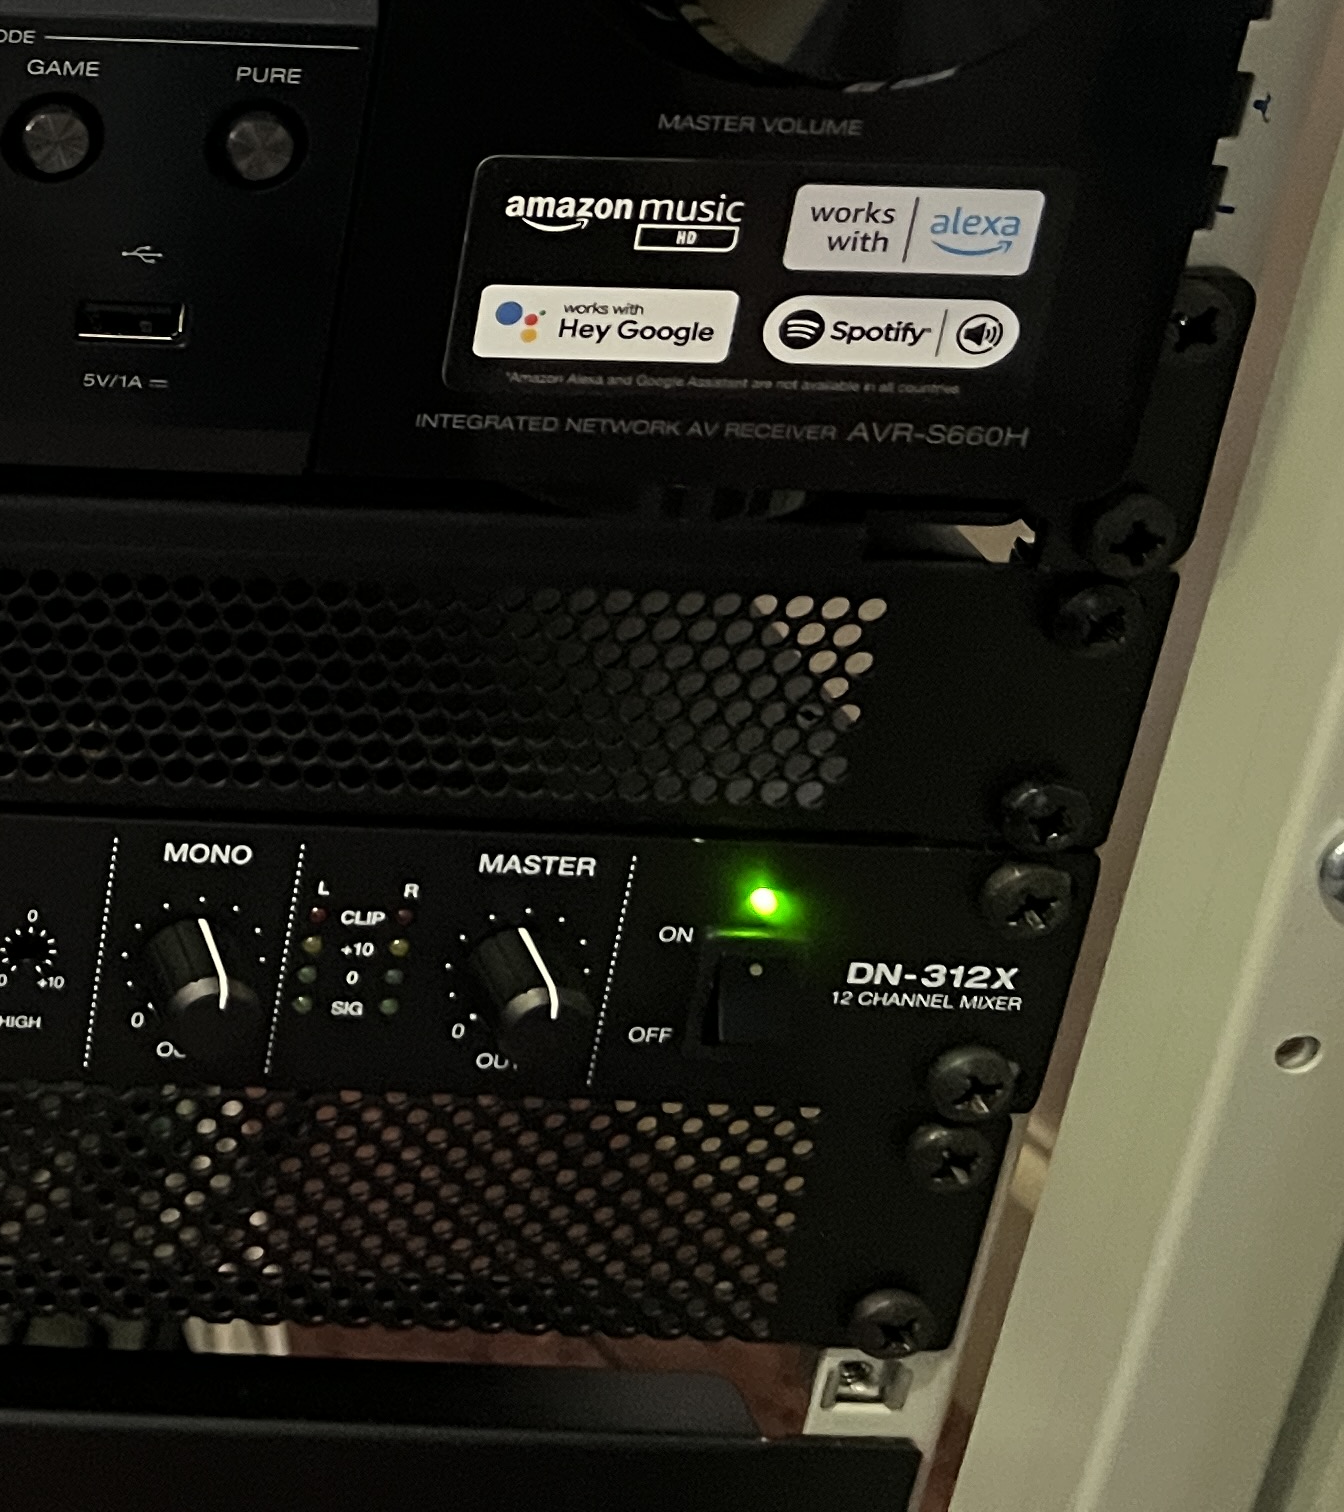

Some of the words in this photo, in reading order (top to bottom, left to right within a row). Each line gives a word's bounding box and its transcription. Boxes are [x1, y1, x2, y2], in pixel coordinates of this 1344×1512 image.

[27, 60, 101, 77] GAME
[236, 67, 302, 84] PURE
[658, 114, 755, 134] MASTER
[762, 118, 863, 137] VOLUME
[505, 196, 633, 220] amazon
[639, 194, 744, 223] music
[811, 202, 895, 225] works
[930, 208, 1021, 238] alexa
[826, 232, 889, 252] with
[563, 302, 608, 316] works
[613, 303, 644, 316] with
[558, 320, 611, 344] Hey
[616, 321, 714, 346] Google
[831, 320, 924, 346] Spotify
[83, 374, 142, 388] 5V/1A
[415, 413, 558, 434] INTEGRATED
[564, 417, 680, 437] NETWORK
[686, 420, 720, 439] AV
[726, 422, 836, 442] RECEIVER
[846, 422, 1029, 447] AVR-S660H
[163, 843, 253, 865] MONO
[478, 853, 597, 877] MASTER
[341, 909, 385, 926] CLIP
[659, 926, 693, 943] ON
[341, 941, 374, 957] +10
[847, 961, 1019, 989] DN-312X
[331, 1001, 363, 1016] SIG
[831, 991, 850, 1006] 12
[856, 992, 953, 1009] CHANNEL
[959, 994, 1022, 1011] MIXER
[452, 1023, 465, 1039] 0
[627, 1026, 673, 1045] OFF
